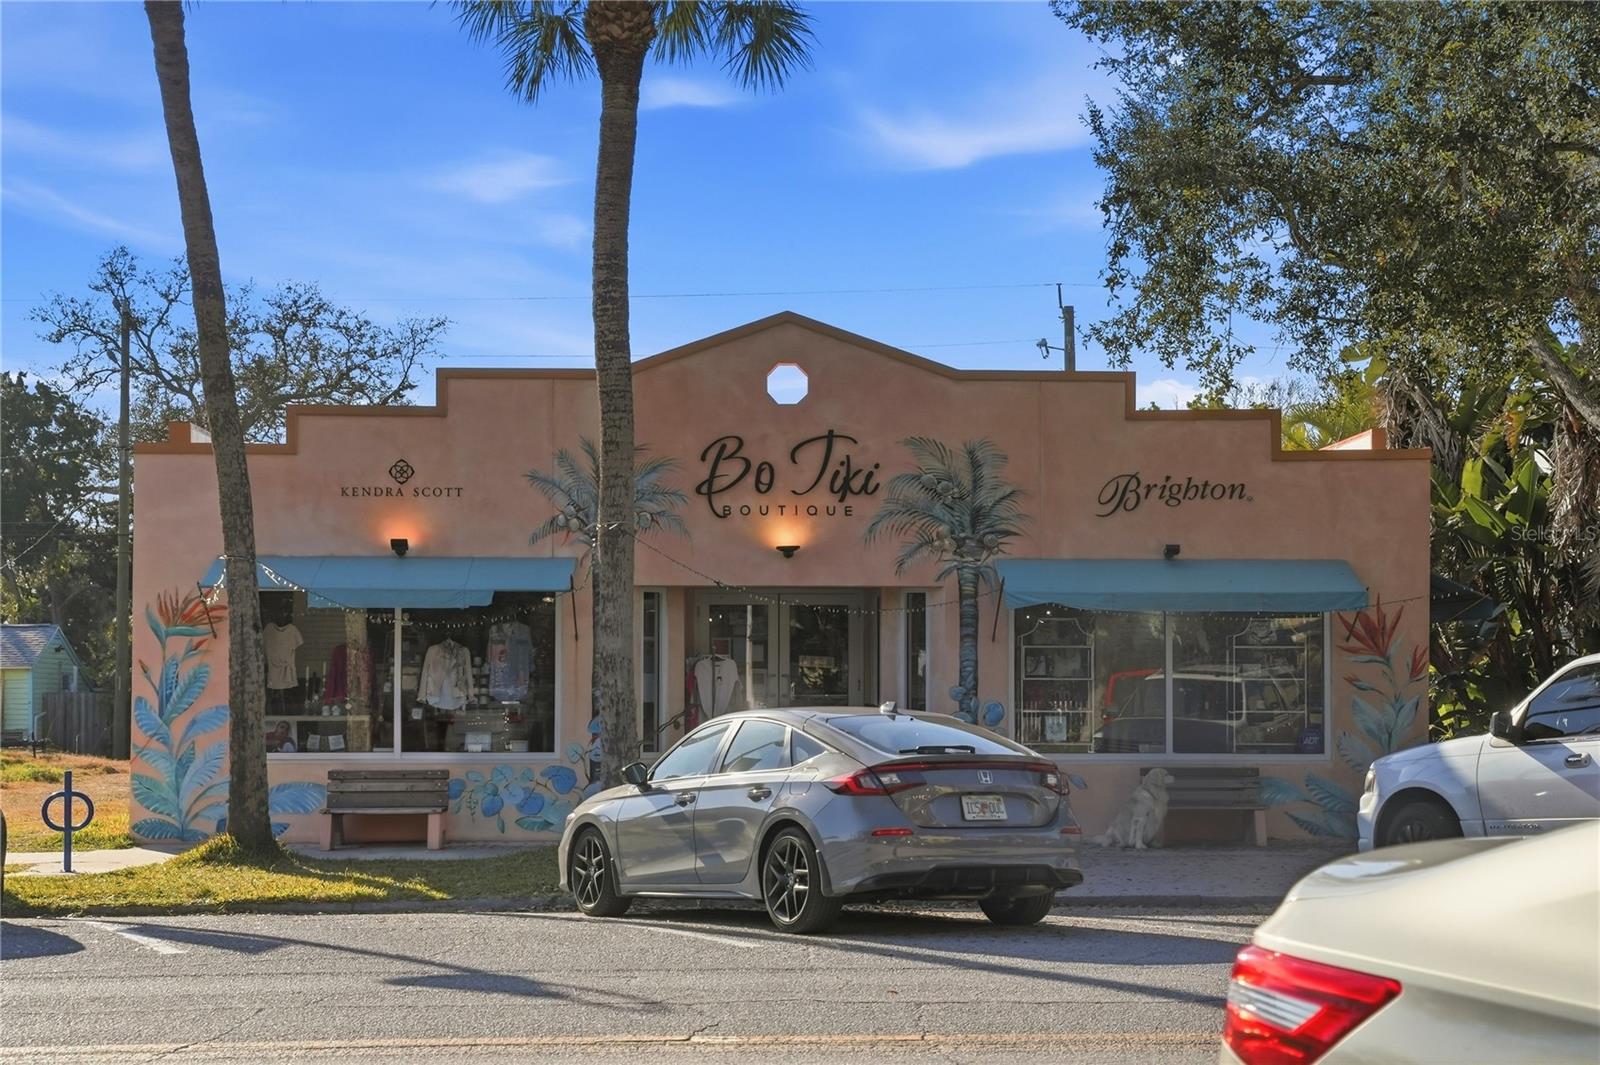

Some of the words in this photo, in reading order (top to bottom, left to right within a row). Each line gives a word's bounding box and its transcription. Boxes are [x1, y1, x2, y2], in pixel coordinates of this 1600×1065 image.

[695, 435, 775, 518] Bo
[790, 429, 880, 503] Tiki
[340, 486, 404, 497] KENDRA
[413, 486, 464, 498] SCOTT
[1096, 472, 1247, 518] Brighton
[722, 504, 853, 517] BOUTIQUE
